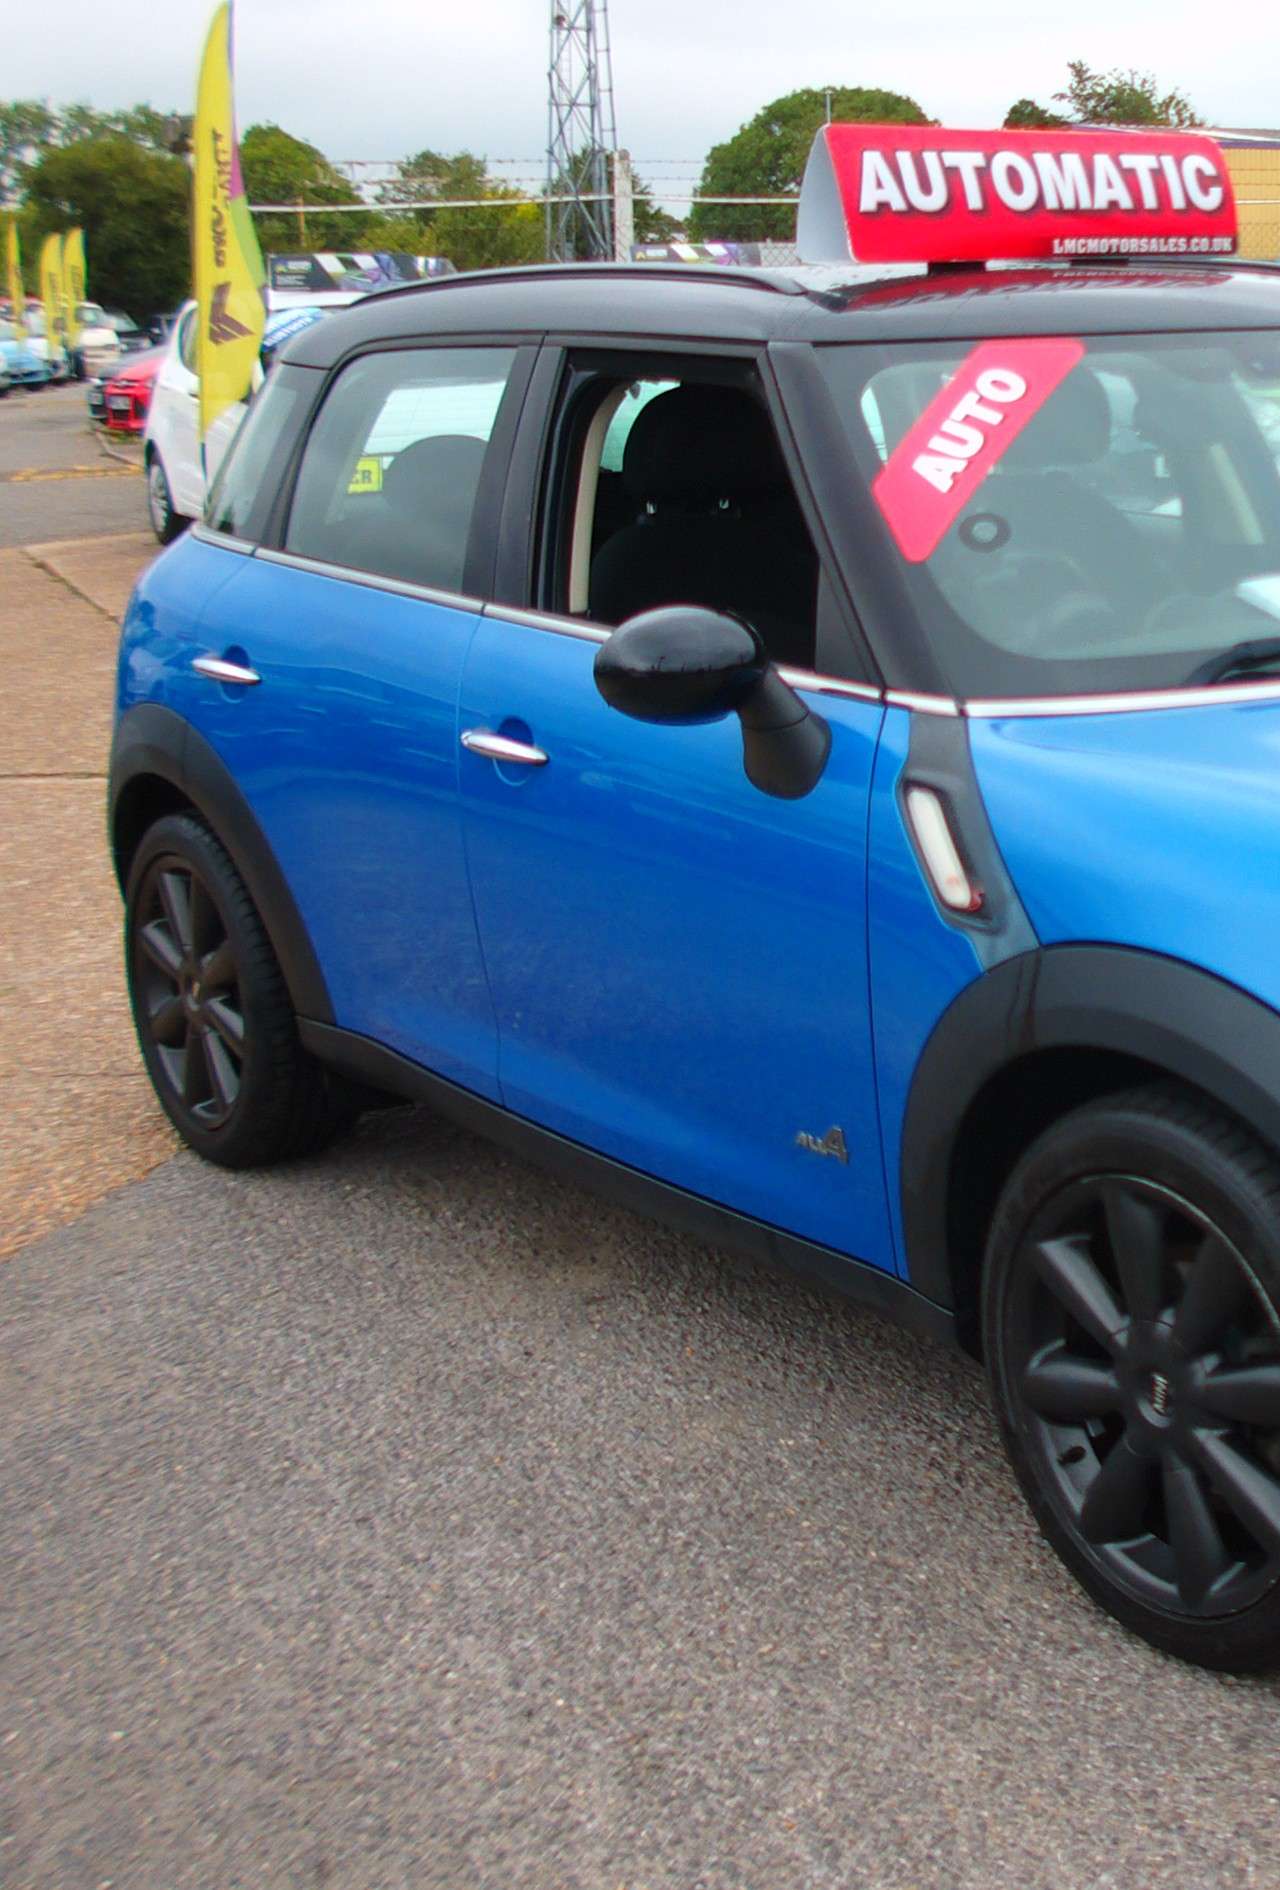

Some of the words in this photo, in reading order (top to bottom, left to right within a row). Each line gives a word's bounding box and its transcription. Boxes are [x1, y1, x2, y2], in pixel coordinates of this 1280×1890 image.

[859, 149, 1224, 214] AUTOMATIC
[1053, 236, 1233, 255] LMCMOTORSALES.CO.UK
[911, 368, 1027, 494] AUTO
